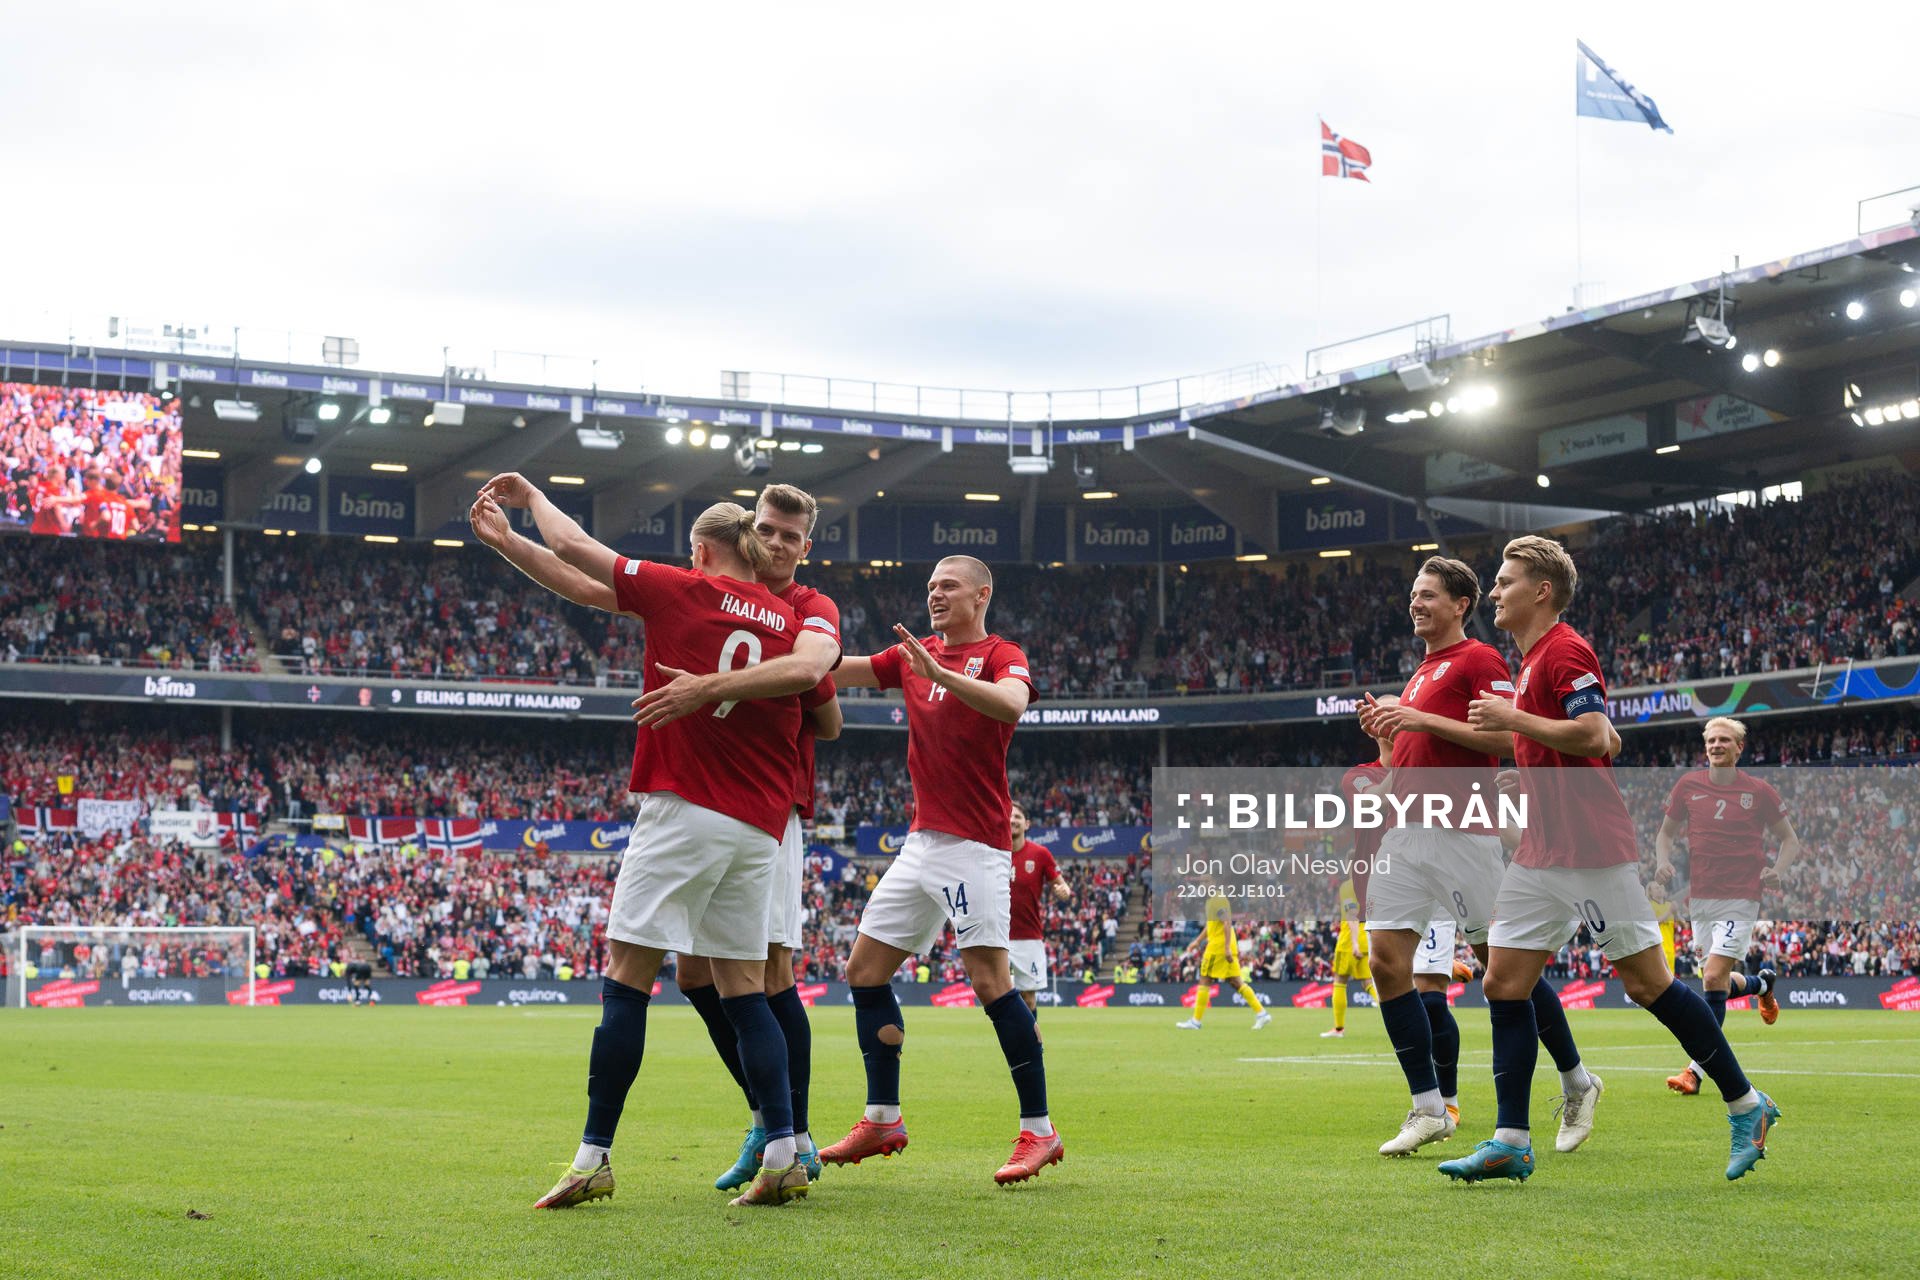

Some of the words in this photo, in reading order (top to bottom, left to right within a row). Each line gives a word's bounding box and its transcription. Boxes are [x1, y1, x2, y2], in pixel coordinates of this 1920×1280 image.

[179, 365, 217, 380] bama
[252, 371, 288, 387] bama
[322, 376, 358, 393] bama
[392, 382, 428, 398] bama
[781, 414, 813, 429] bama
[842, 419, 873, 434] bama
[902, 425, 932, 440] bama
[975, 429, 1007, 443] bama
[1067, 429, 1100, 443] bama
[182, 487, 218, 507] ma
[340, 492, 405, 519] bama
[1306, 505, 1366, 532] bama
[933, 521, 998, 545] bama
[1085, 521, 1149, 546] bama
[1171, 522, 1227, 545] bama
[721, 593, 786, 632] HAALAND
[712, 630, 763, 719] 9
[144, 676, 196, 698] bama
[1409, 675, 1425, 702] 8
[392, 689, 402, 703] 9
[416, 690, 464, 704] ERLING
[467, 692, 511, 707] BRAUT
[515, 694, 582, 709] HAALAND
[1316, 696, 1358, 716] bama
[1620, 693, 1693, 717] HAALAND
[1043, 709, 1088, 723] BRAUT
[1092, 708, 1160, 723] HAALAND
[1713, 799, 1728, 821] 2
[888, 834, 906, 849] Ben
[1030, 829, 1060, 845] endit
[1082, 828, 1115, 848] Bendit
[942, 882, 970, 919] 14
[1452, 890, 1469, 918] 8
[1573, 899, 1606, 934] 10
[1426, 927, 1437, 950] 3
[1724, 920, 1736, 939] 2
[1030, 961, 1039, 976] 4
[128, 988, 182, 1003] equinor
[508, 988, 558, 1003] equinor
[1129, 992, 1159, 1005] equinor
[1789, 989, 1836, 1005] equinor
